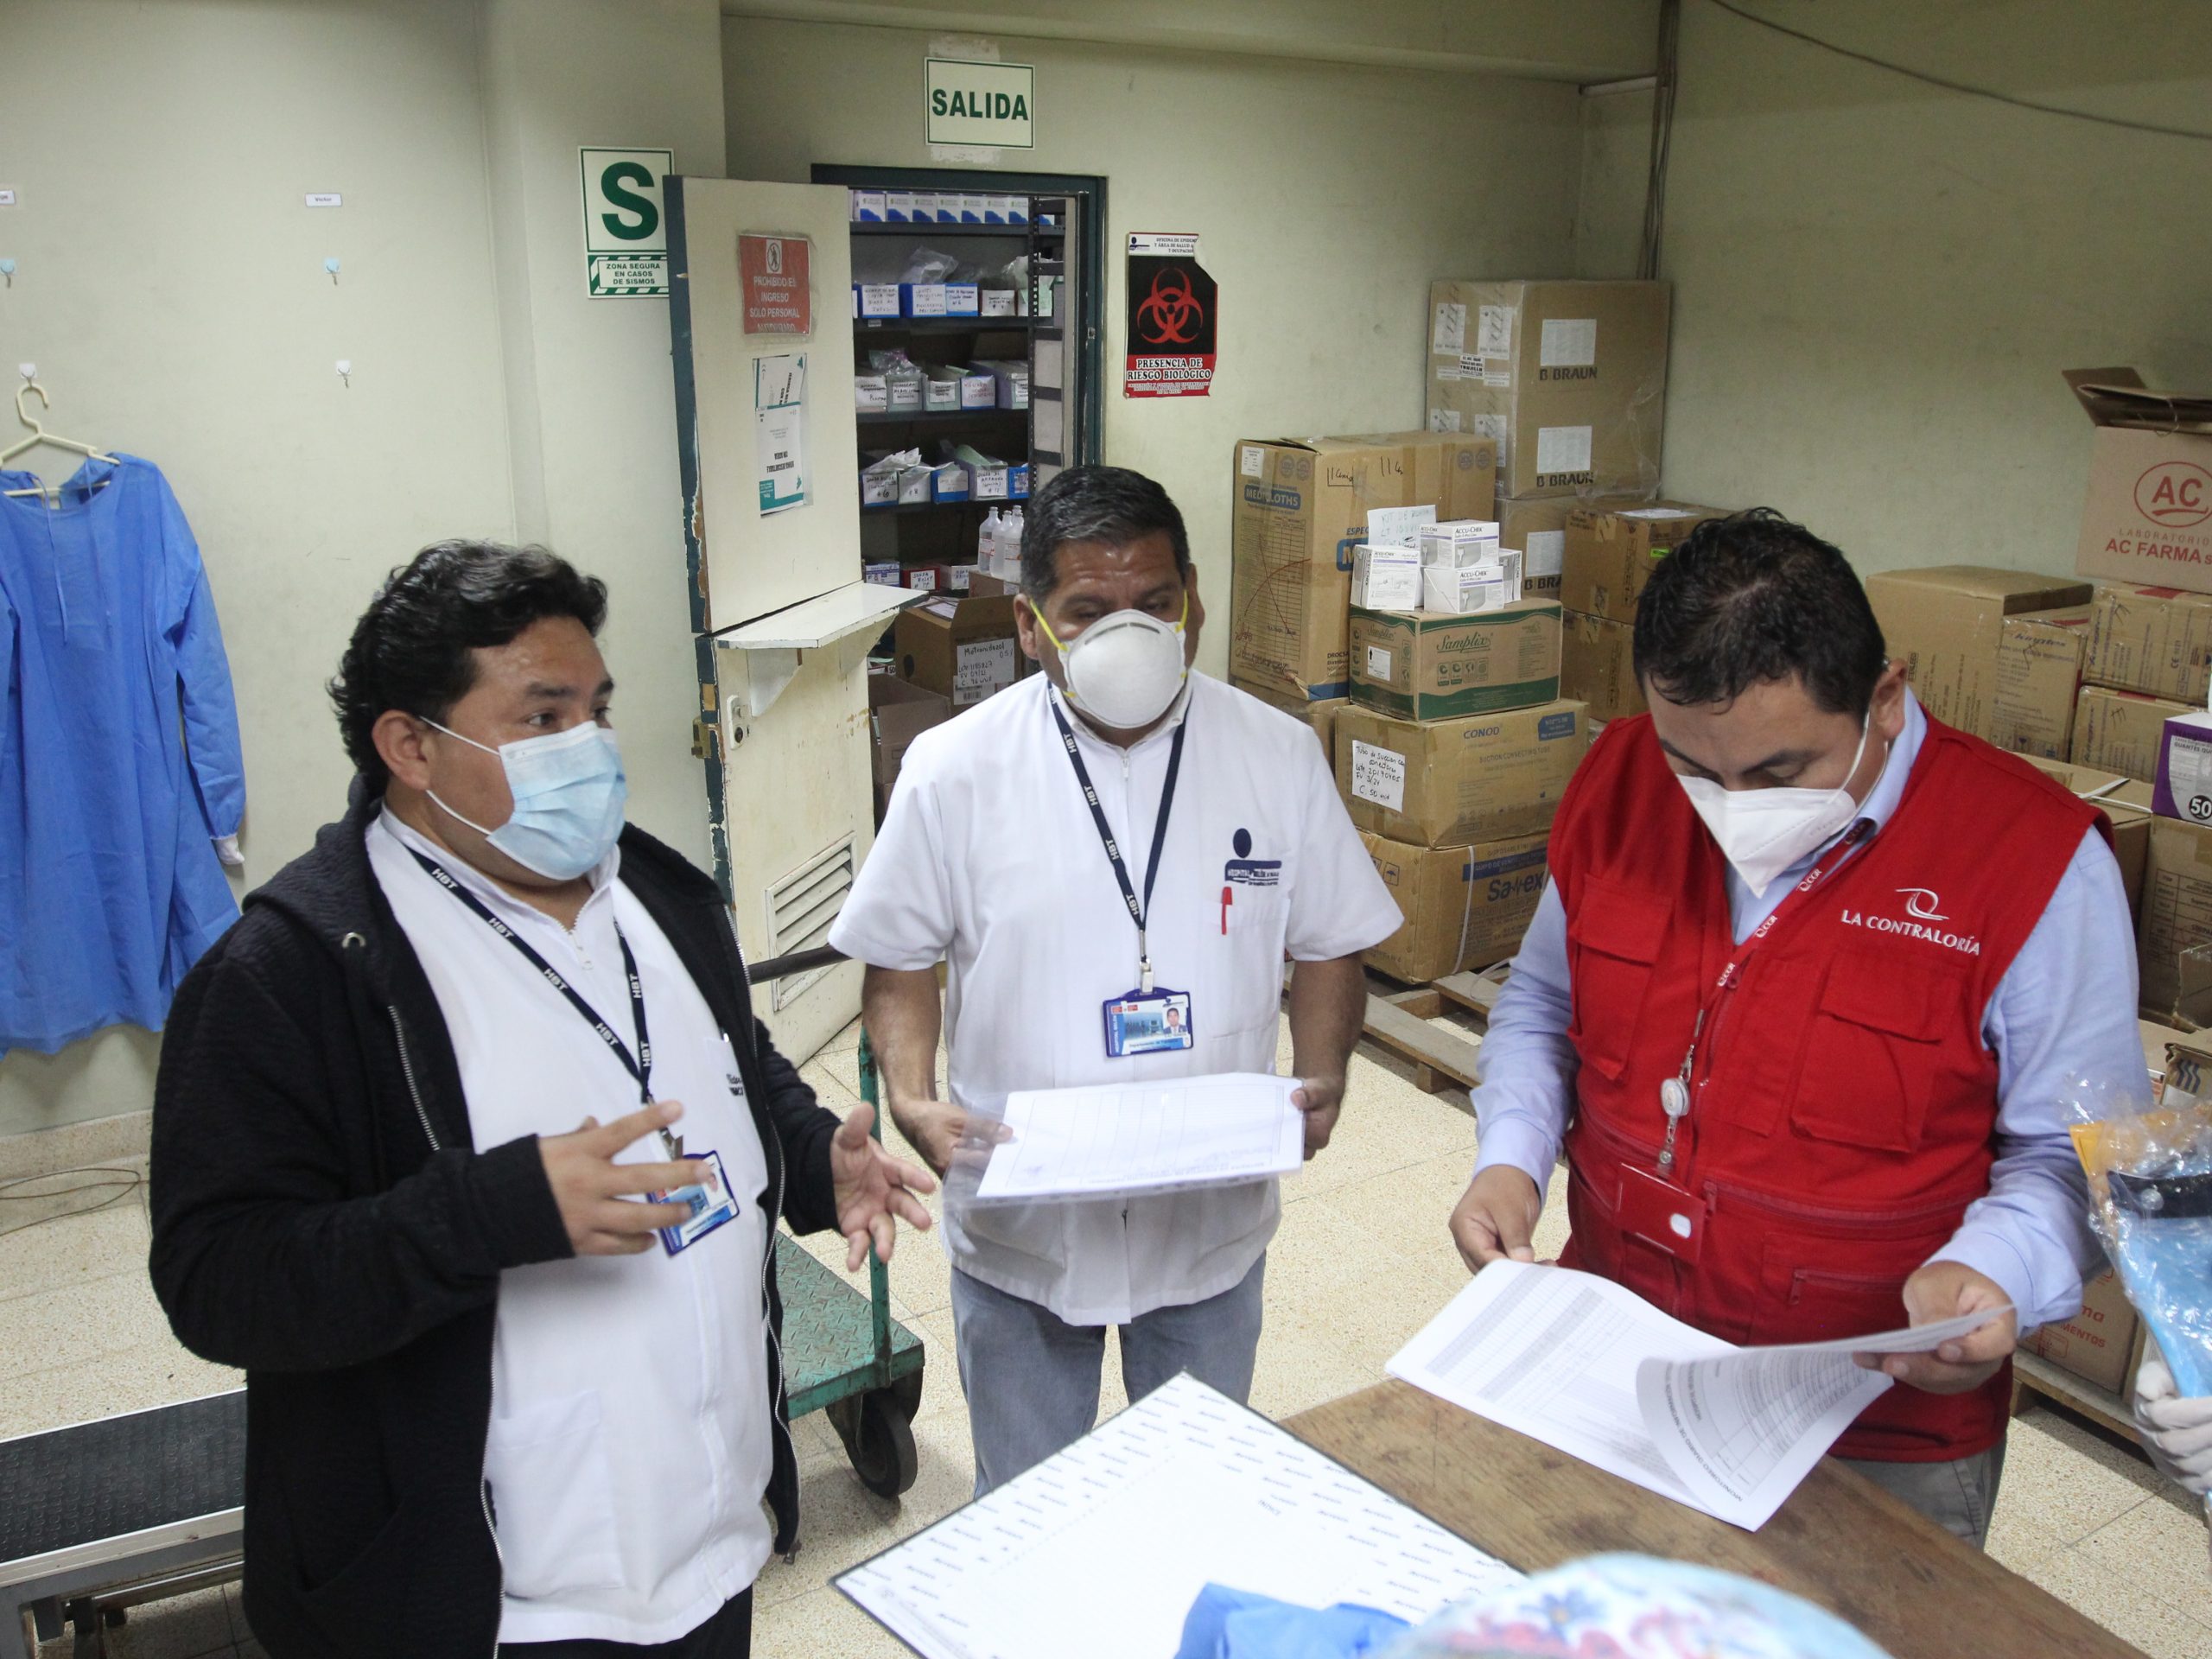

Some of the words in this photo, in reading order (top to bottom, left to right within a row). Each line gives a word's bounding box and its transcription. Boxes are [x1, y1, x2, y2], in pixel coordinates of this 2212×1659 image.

[931, 88, 1029, 121] SALIDA
[601, 161, 659, 241] S
[753, 276, 787, 287] PROHIBIDO
[760, 292, 790, 302] INGRESO
[767, 308, 800, 318] PERSONAL
[1136, 358, 1188, 369] PRESENCIA
[1189, 358, 1204, 368] DE
[1552, 367, 1598, 381] BRAUN
[1127, 370, 1161, 381] RIESGO
[1548, 472, 1594, 486] BRAUN
[2151, 475, 2203, 507] AC
[1455, 525, 1483, 534] ACCU-CHEK
[2119, 528, 2210, 546] LABORATORIO
[2105, 537, 2132, 554] AC
[2137, 542, 2202, 564] FARMA
[1459, 570, 1488, 579] ACCU-CHEK
[1437, 632, 1492, 653] Samplix
[1063, 733, 1077, 754] HBT
[2174, 742, 2201, 753] GUANTES
[1084, 785, 1099, 806] HBT
[2190, 798, 2212, 818] 50
[1105, 838, 1120, 861] HBT
[431, 867, 460, 889] HBT
[1125, 893, 1140, 916] HBT
[487, 917, 516, 938] HBT
[1840, 909, 1862, 927] LA
[1866, 915, 1981, 957] CONTRALORÍA
[543, 968, 569, 991] HBT
[629, 973, 642, 999] HBT
[595, 1022, 620, 1046] HBT
[640, 1039, 652, 1068] HBT
[1685, 1438, 1704, 1465] DIARIO
[1703, 1463, 1743, 1502] MONITOREO
